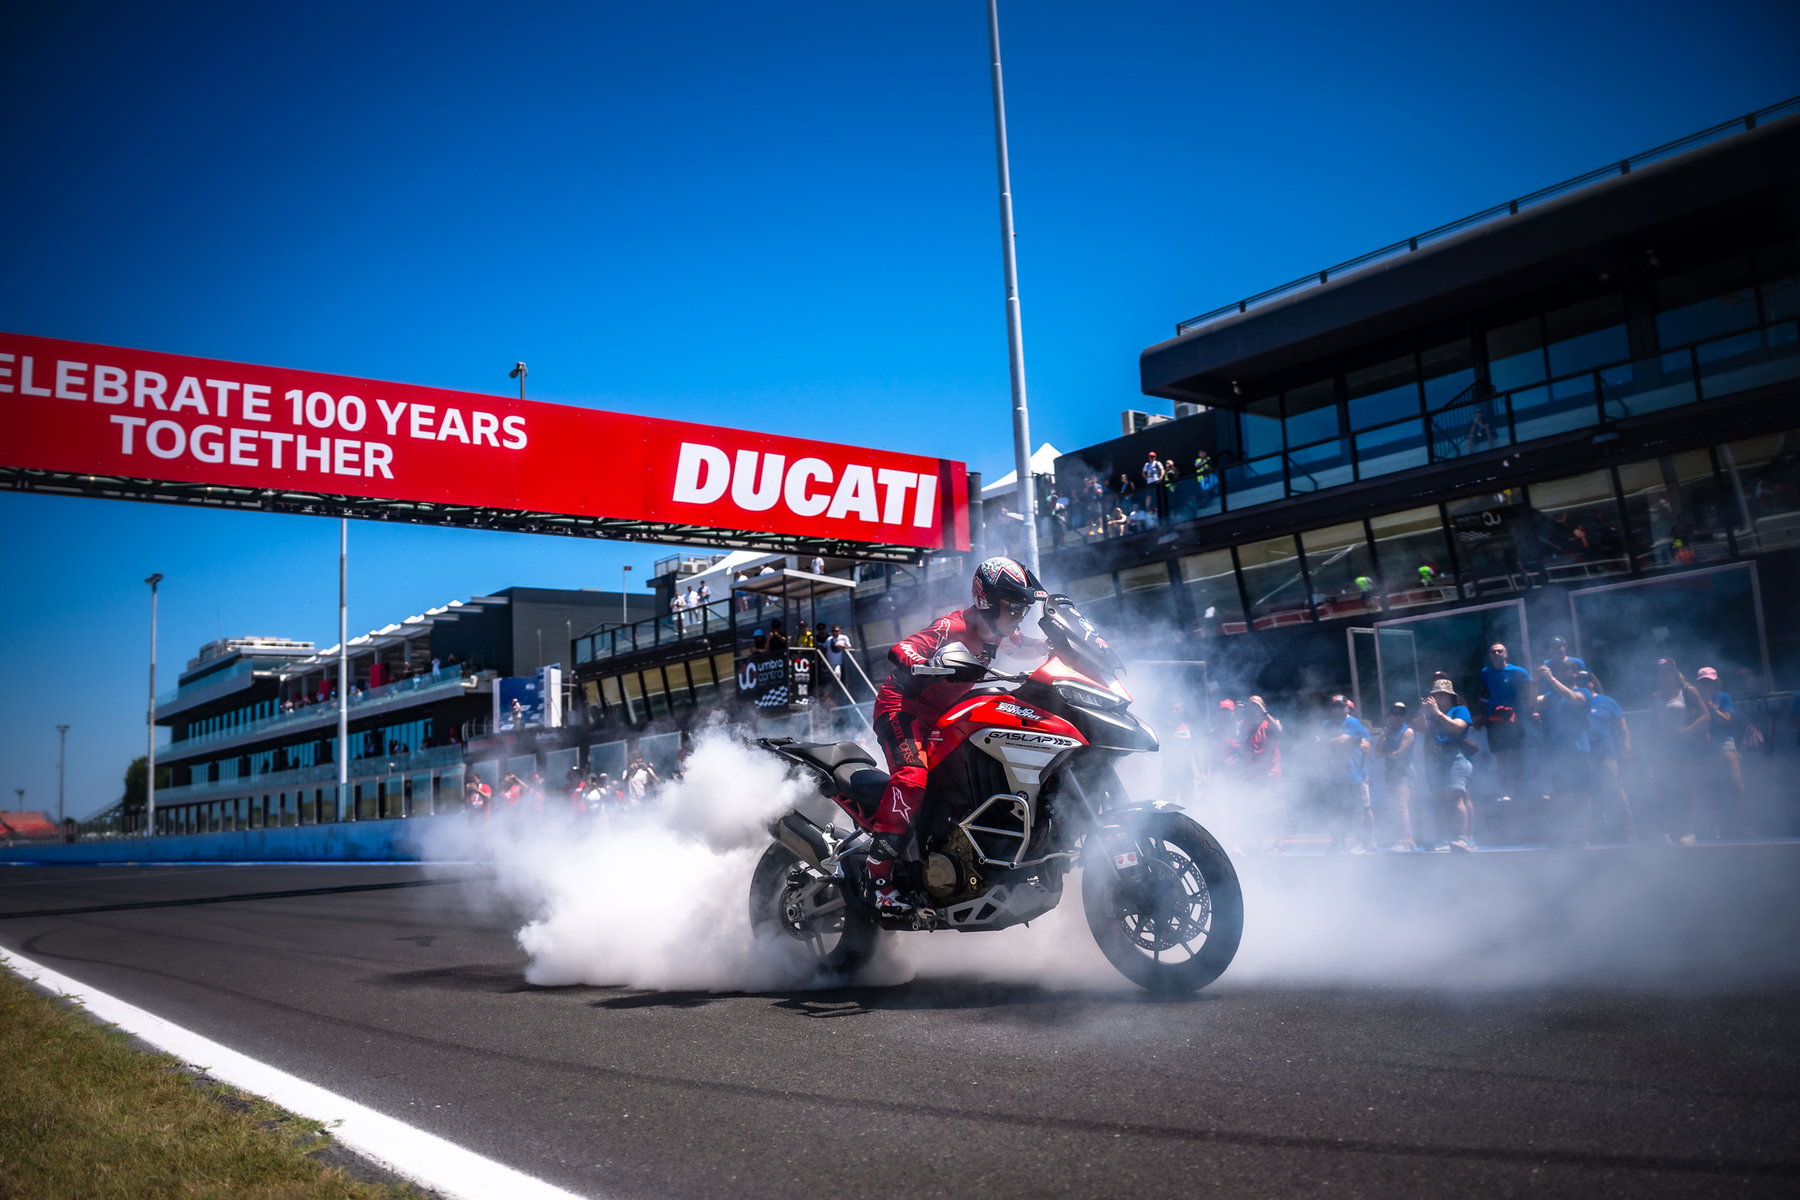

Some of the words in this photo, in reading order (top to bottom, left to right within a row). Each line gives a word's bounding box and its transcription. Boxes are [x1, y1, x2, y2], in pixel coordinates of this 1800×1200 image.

[109, 414, 394, 480] TOGETHER
[284, 389, 367, 432] 100
[376, 399, 528, 450] YEARS
[672, 441, 938, 529] DUCATI
[989, 731, 1053, 743] GASLAP
